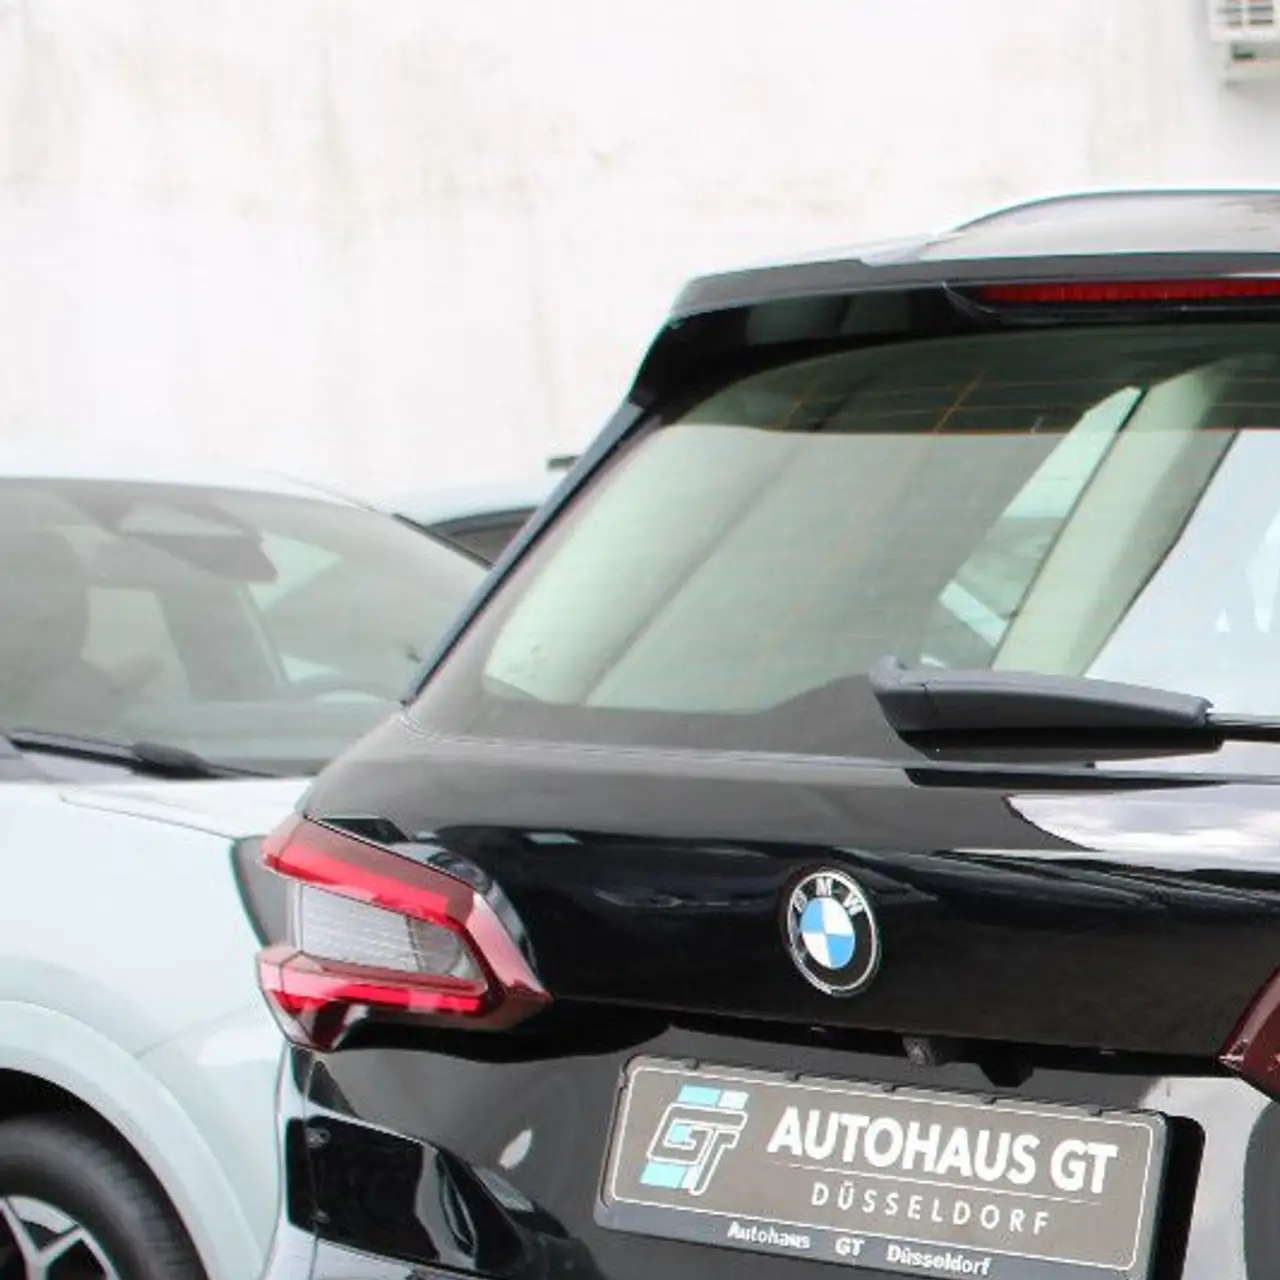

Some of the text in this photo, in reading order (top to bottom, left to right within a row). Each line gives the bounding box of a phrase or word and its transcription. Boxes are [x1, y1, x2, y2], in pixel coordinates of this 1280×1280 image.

[790, 876, 866, 916] BMW
[766, 1106, 1120, 1195] AUTOHAUS GT
[810, 1181, 1050, 1236] DÜSSELDORF
[727, 1221, 993, 1276] Autohaus GT Düsseldorf
